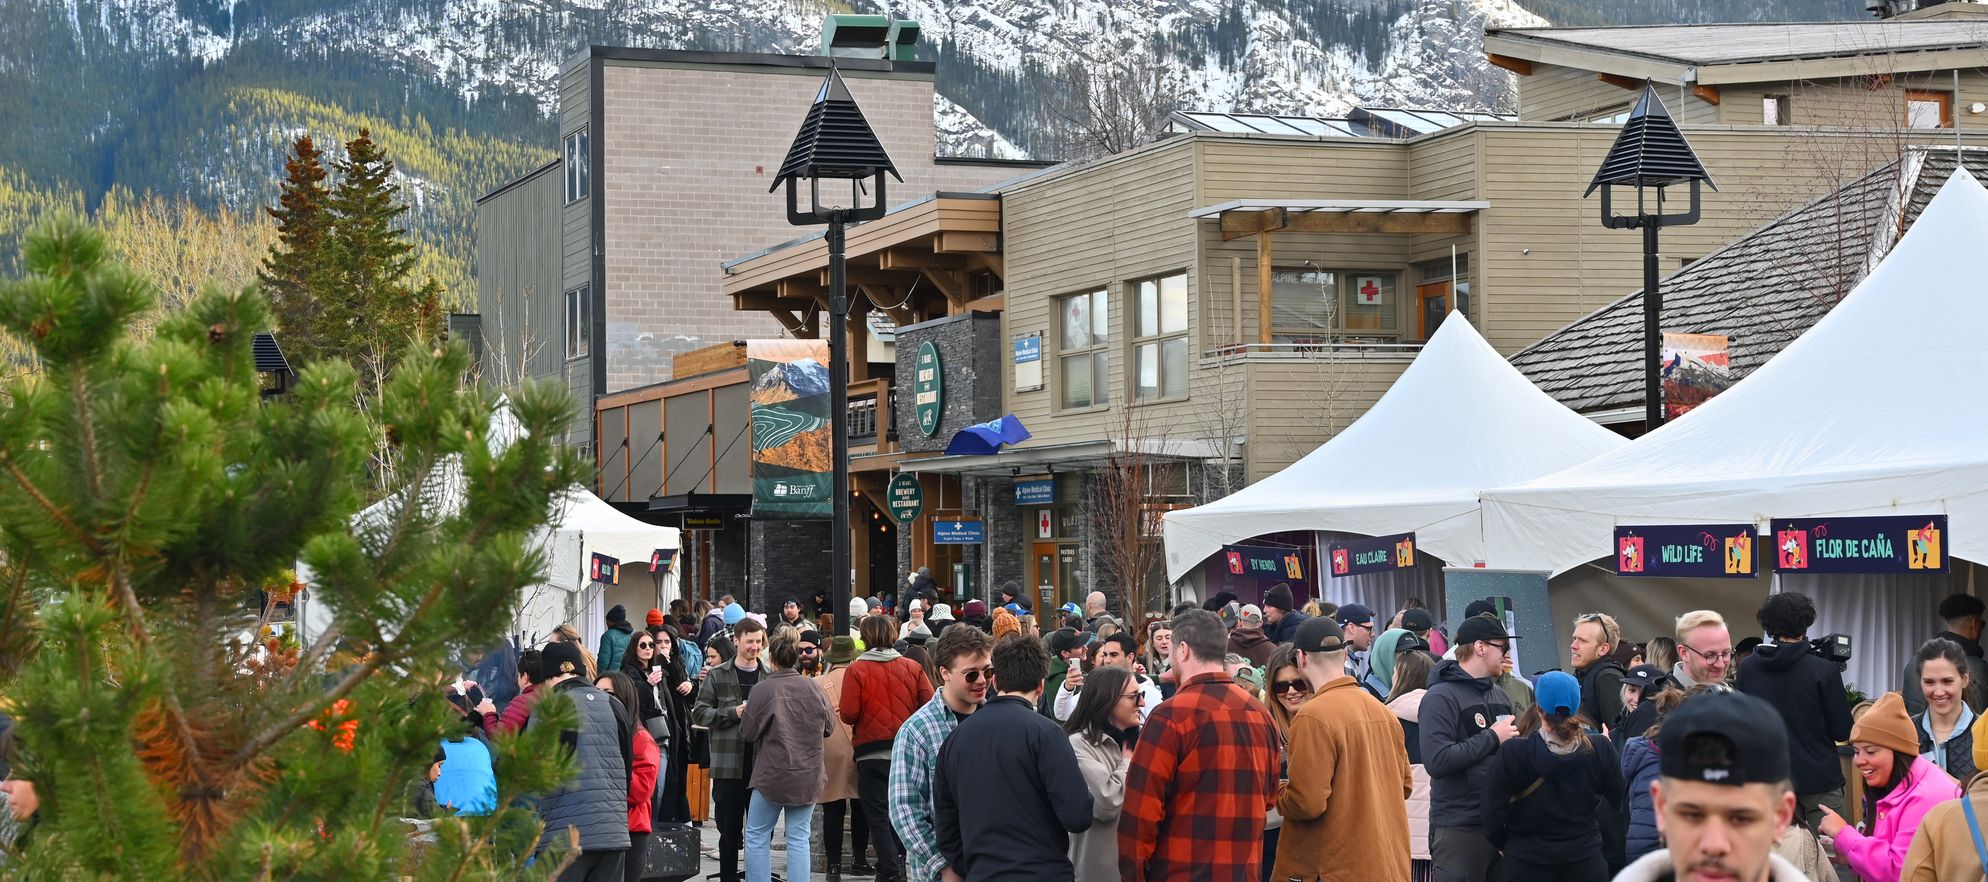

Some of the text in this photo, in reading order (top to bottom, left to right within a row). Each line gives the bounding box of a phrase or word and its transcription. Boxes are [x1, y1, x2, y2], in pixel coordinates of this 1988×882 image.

[919, 368, 934, 382] BREWERY
[916, 390, 937, 406] RESTAURANT
[790, 485, 816, 498] Banff
[896, 488, 915, 496] BREWERY
[1816, 533, 1894, 558] FLOR DE CAÑA
[1356, 550, 1387, 564] EAU CLAIRE
[1662, 545, 1703, 563] WILD LIFE
[1250, 558, 1276, 571] BY HENDO
